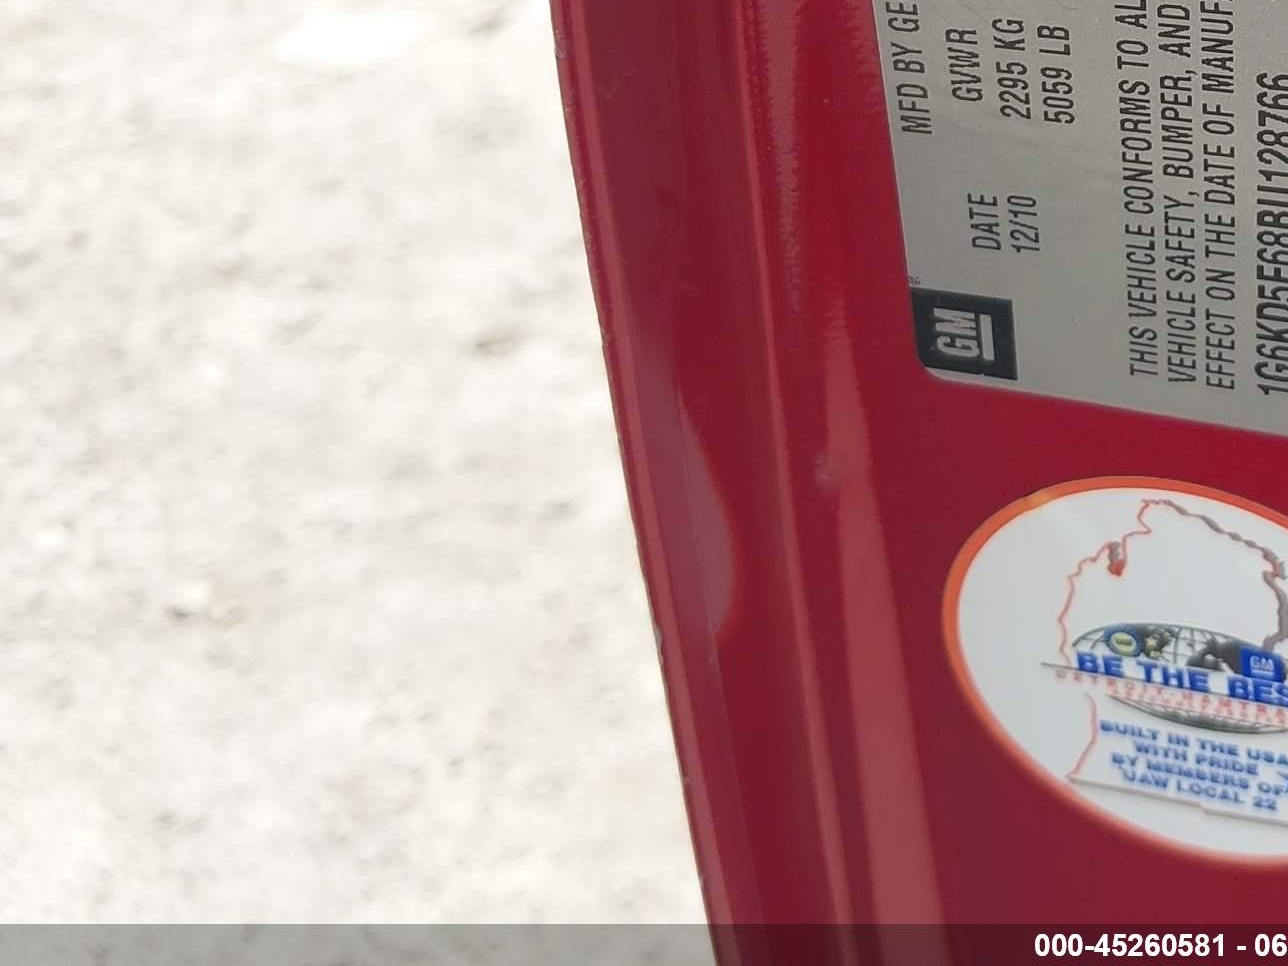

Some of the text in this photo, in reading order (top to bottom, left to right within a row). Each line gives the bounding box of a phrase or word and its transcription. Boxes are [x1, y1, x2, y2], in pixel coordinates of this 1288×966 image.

[1116, 40, 1149, 70] TO
[1157, 4, 1191, 58] AND
[891, 42, 925, 73] BY
[945, 29, 983, 101] GVWR
[992, 18, 1031, 119] 2295 KG
[1037, 26, 1075, 124] 5059 LB
[897, 84, 932, 134] MFD
[1160, 70, 1198, 178] BUMPER,
[1202, 103, 1234, 135] OF
[1118, 80, 1154, 214] CONFORMS
[1204, 144, 1235, 205] DATE
[968, 193, 1001, 250] DATE
[1007, 196, 1040, 253] 12/10
[1164, 192, 1200, 283] SAFETY,
[1204, 214, 1235, 258] THE
[1125, 224, 1157, 317] VEHICLE
[1205, 268, 1235, 300] ON
[935, 308, 979, 355] GM
[1129, 326, 1158, 376] THIS
[1166, 290, 1196, 382] VEHICLE
[1206, 308, 1235, 390] EFFECT
[1077, 650, 1123, 677] BE
[1136, 659, 1208, 693] THE
[1250, 655, 1274, 671] GM
[1100, 720, 1160, 740] BUILT
[1168, 732, 1189, 746] IN
[1197, 738, 1238, 756] THE
[1134, 741, 1259, 775] WITH PRIDE
[1112, 752, 1284, 796] BY MEMBERS OF
[1121, 767, 1277, 810] UAW LOCAL 22
